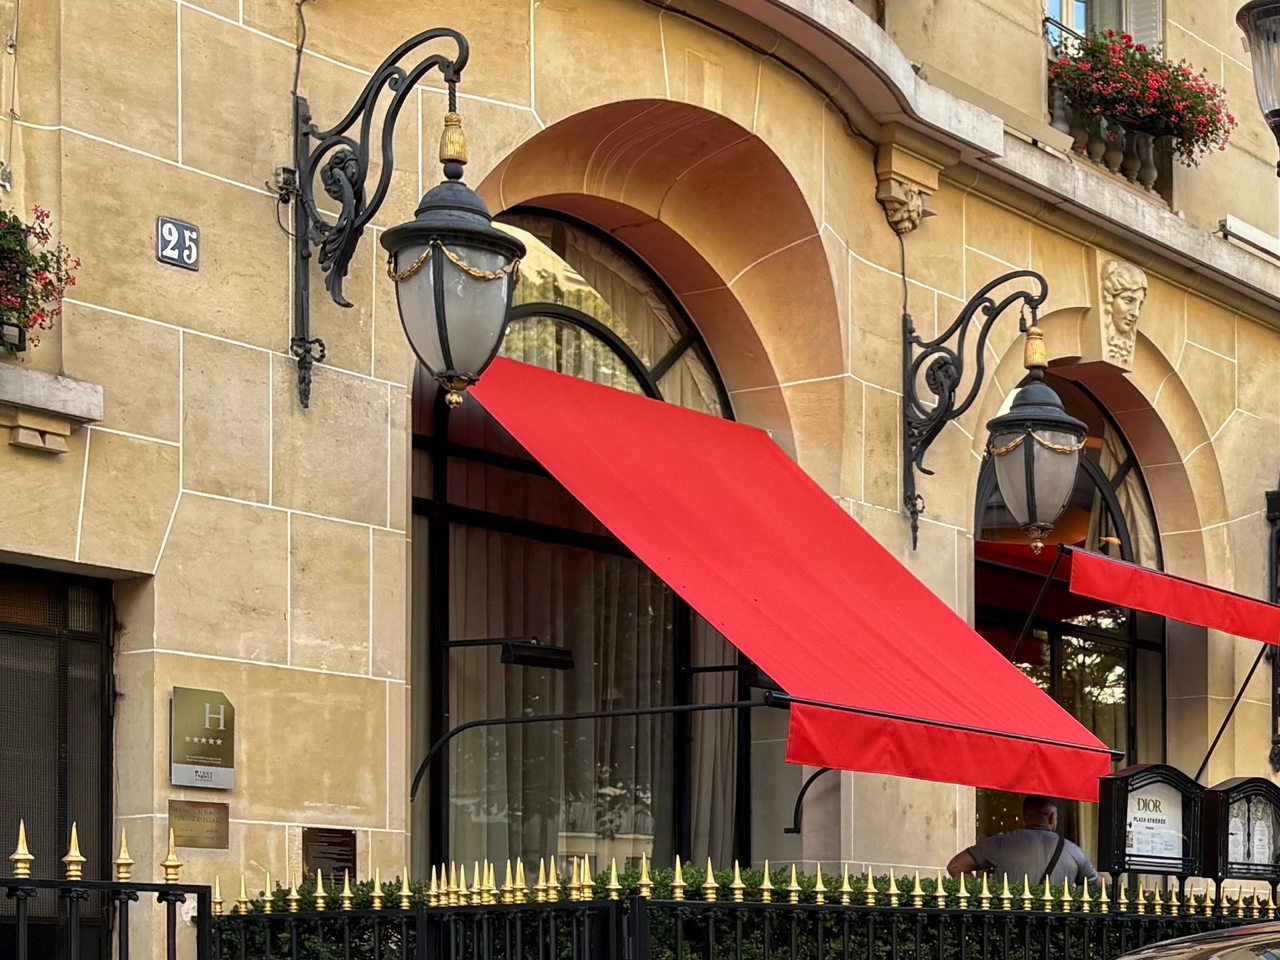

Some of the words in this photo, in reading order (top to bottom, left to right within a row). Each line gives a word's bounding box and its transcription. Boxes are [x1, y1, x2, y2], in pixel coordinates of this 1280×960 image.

[162, 222, 198, 264] 25
[204, 702, 227, 731] H
[1137, 797, 1162, 813] DIOR
